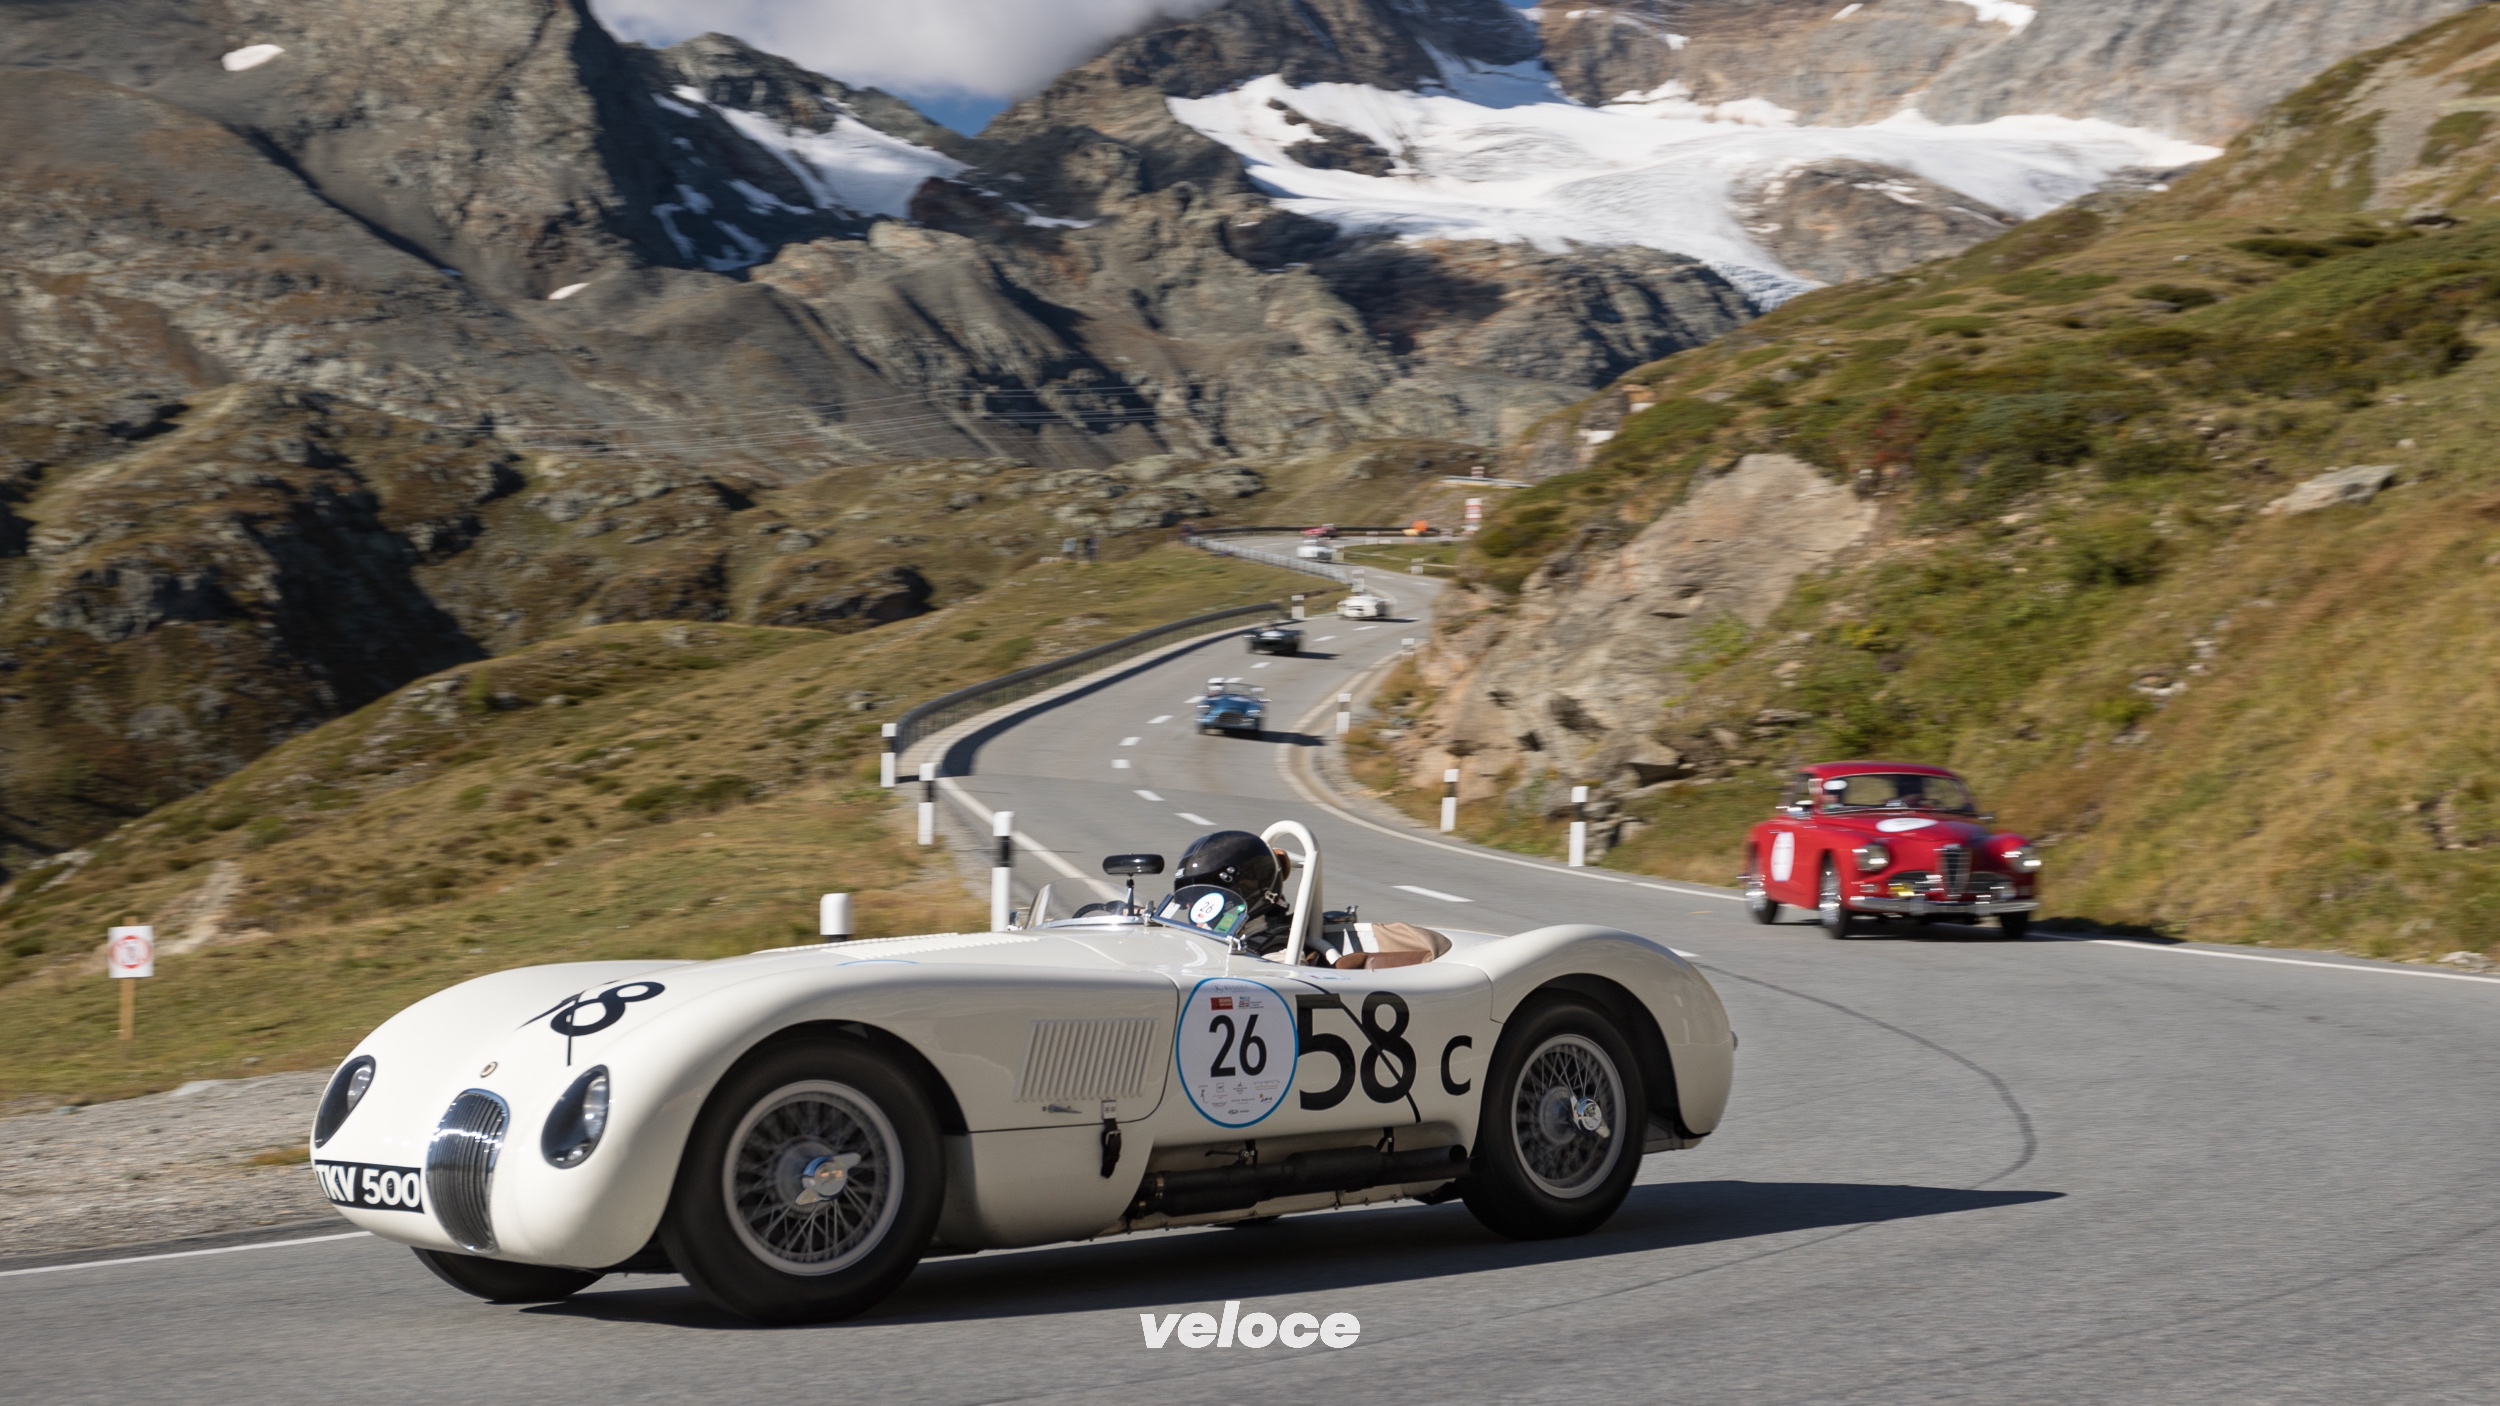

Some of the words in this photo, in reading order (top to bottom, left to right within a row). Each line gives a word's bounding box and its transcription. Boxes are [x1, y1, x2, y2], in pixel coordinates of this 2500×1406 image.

[1200, 901, 1215, 914] 26
[1209, 1014, 1267, 1078] 26
[1296, 990, 1417, 1111] 58
[314, 1164, 357, 1202] TKV
[362, 1168, 421, 1208] 500
